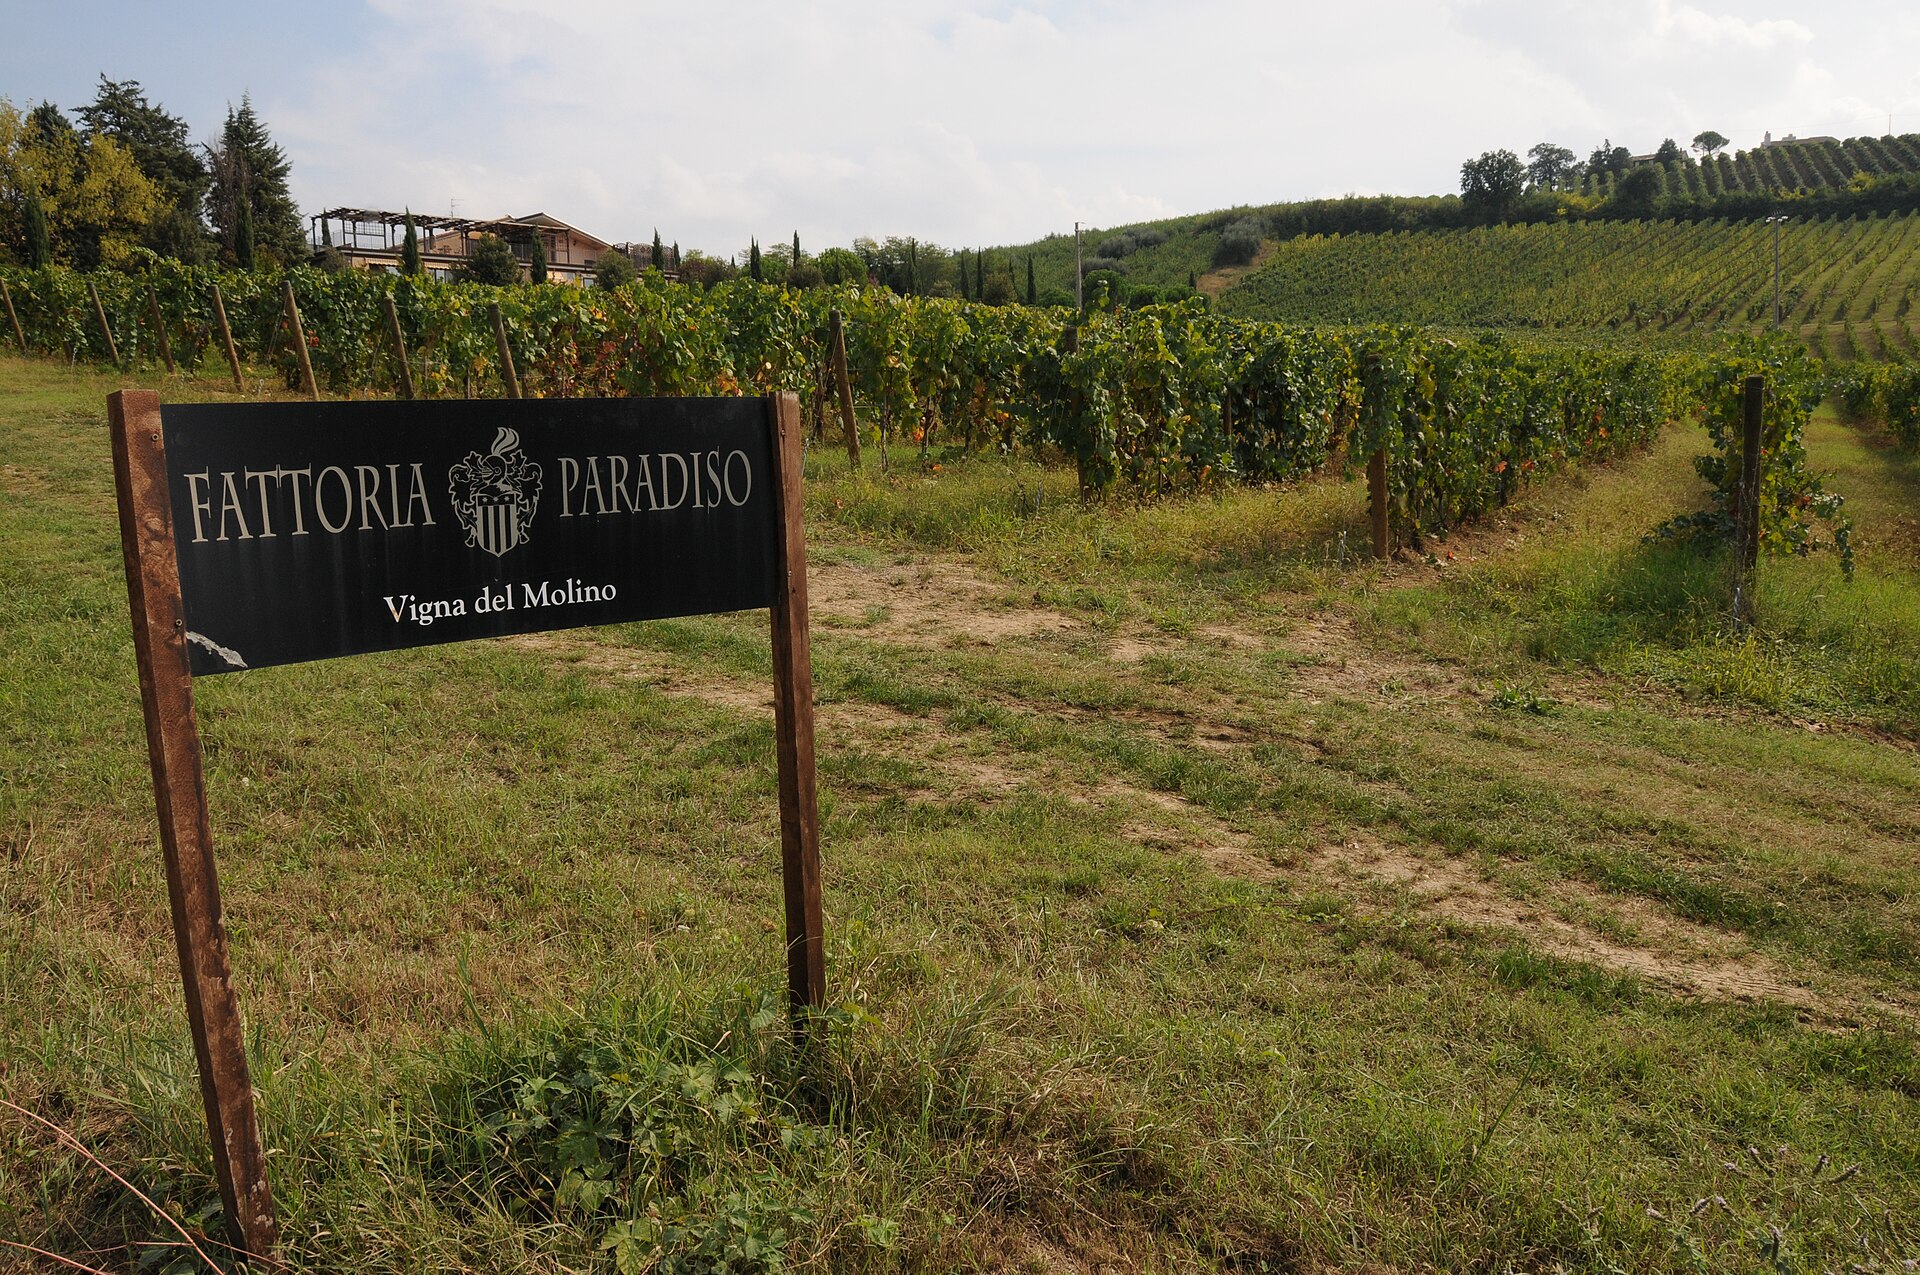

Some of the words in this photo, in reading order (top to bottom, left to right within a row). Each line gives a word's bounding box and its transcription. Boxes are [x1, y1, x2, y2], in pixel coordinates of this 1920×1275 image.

[183, 463, 436, 543] FATTORIA
[557, 445, 752, 517] PARADISO
[383, 595, 467, 626] Vigna
[475, 584, 515, 614] del
[522, 578, 617, 609] Molino
